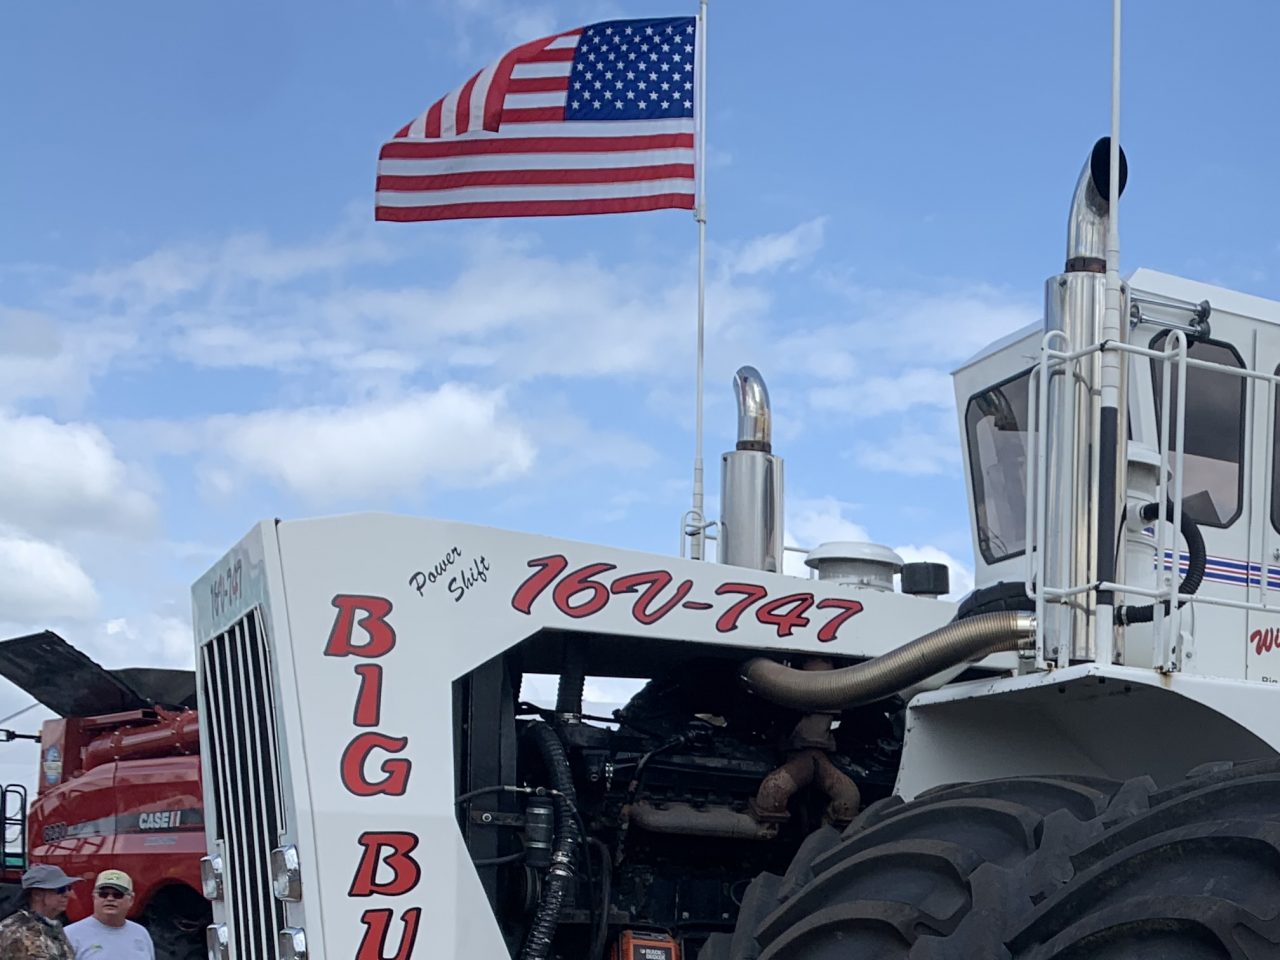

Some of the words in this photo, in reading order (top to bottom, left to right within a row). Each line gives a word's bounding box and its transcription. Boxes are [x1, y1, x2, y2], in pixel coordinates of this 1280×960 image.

[408, 545, 462, 598] Power
[447, 554, 492, 603] Shift
[511, 553, 864, 643] 16V-747
[323, 593, 413, 797] BIG
[139, 811, 169, 829] CASE
